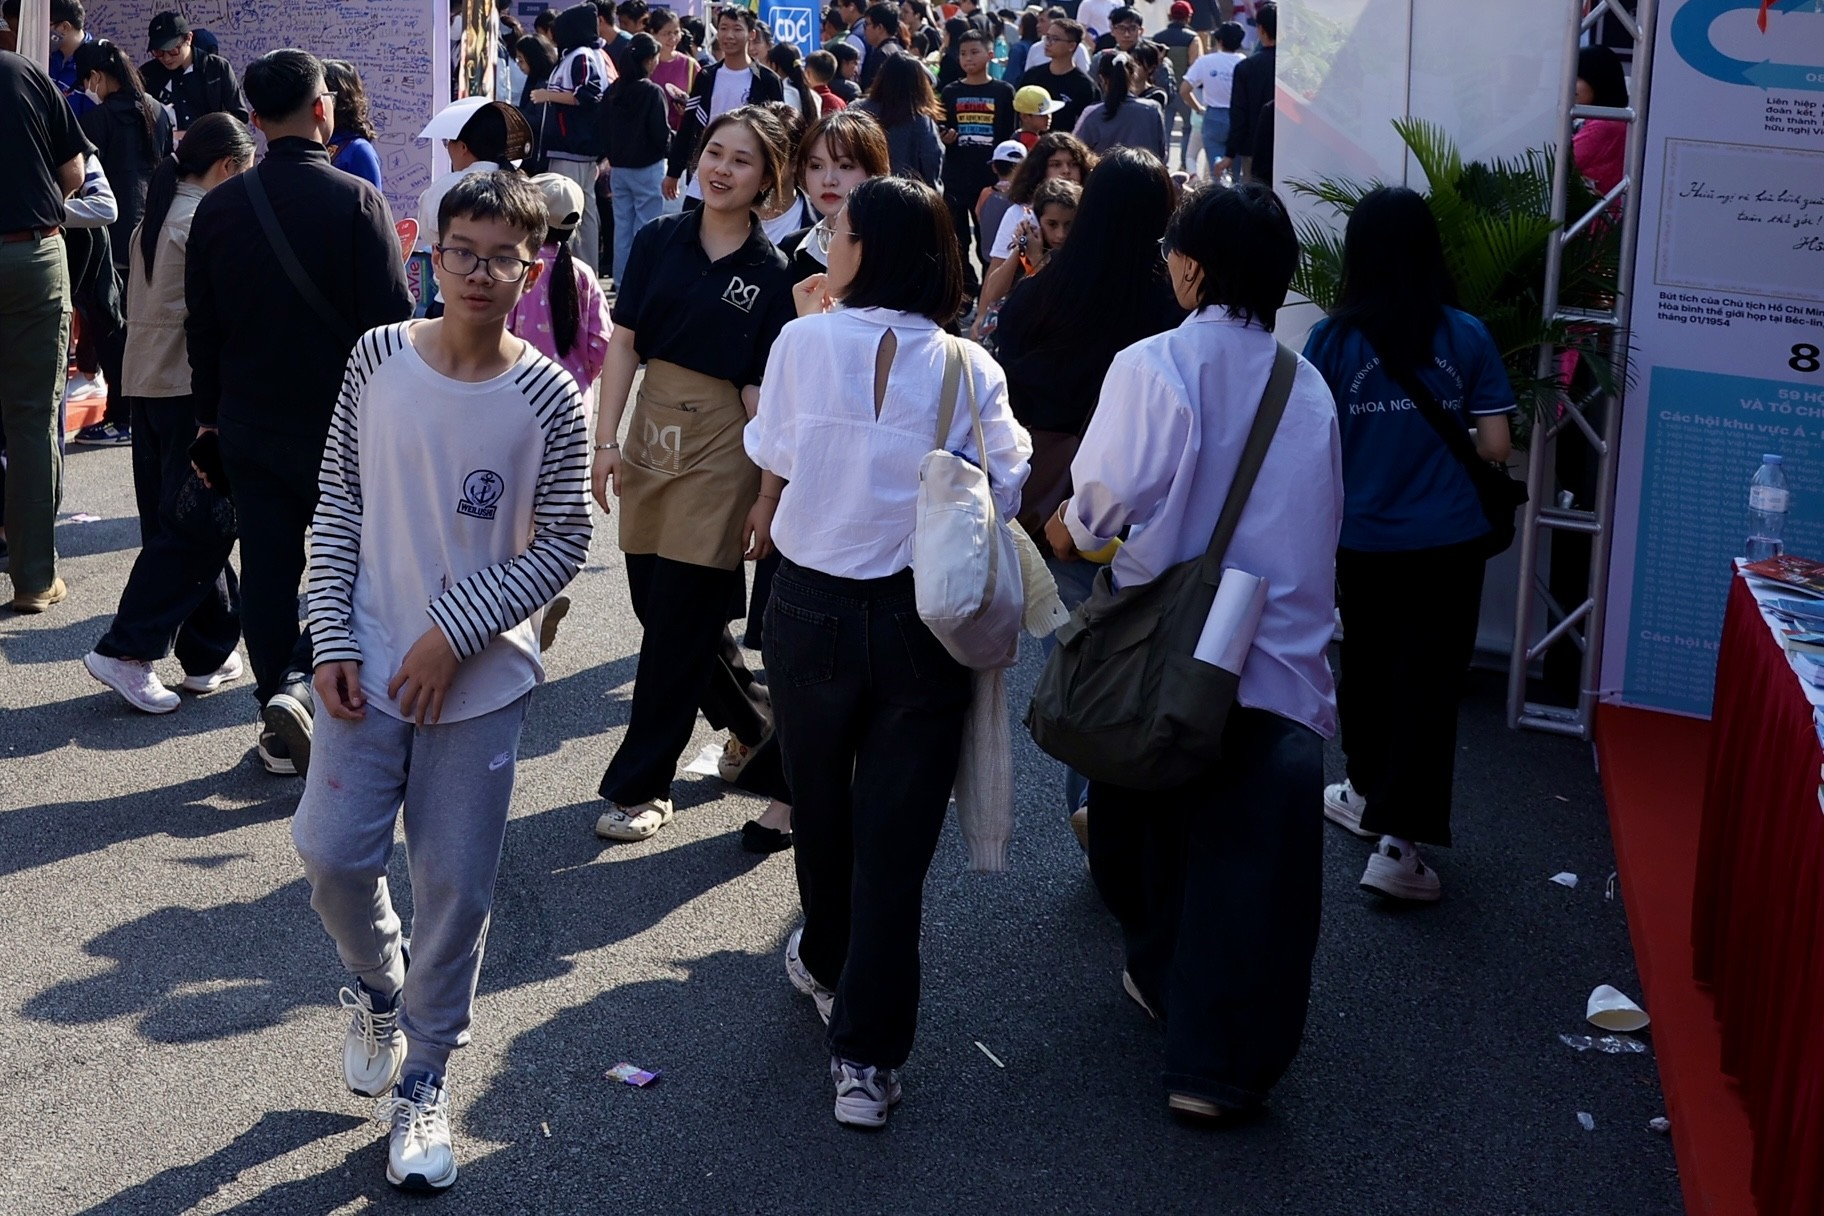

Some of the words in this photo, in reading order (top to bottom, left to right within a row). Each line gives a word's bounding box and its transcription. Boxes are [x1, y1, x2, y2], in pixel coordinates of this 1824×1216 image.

[775, 17, 807, 43] CDC
[1349, 400, 1386, 416] KHOA
[1659, 409, 1691, 424] Các
[1723, 416, 1755, 431] khu
